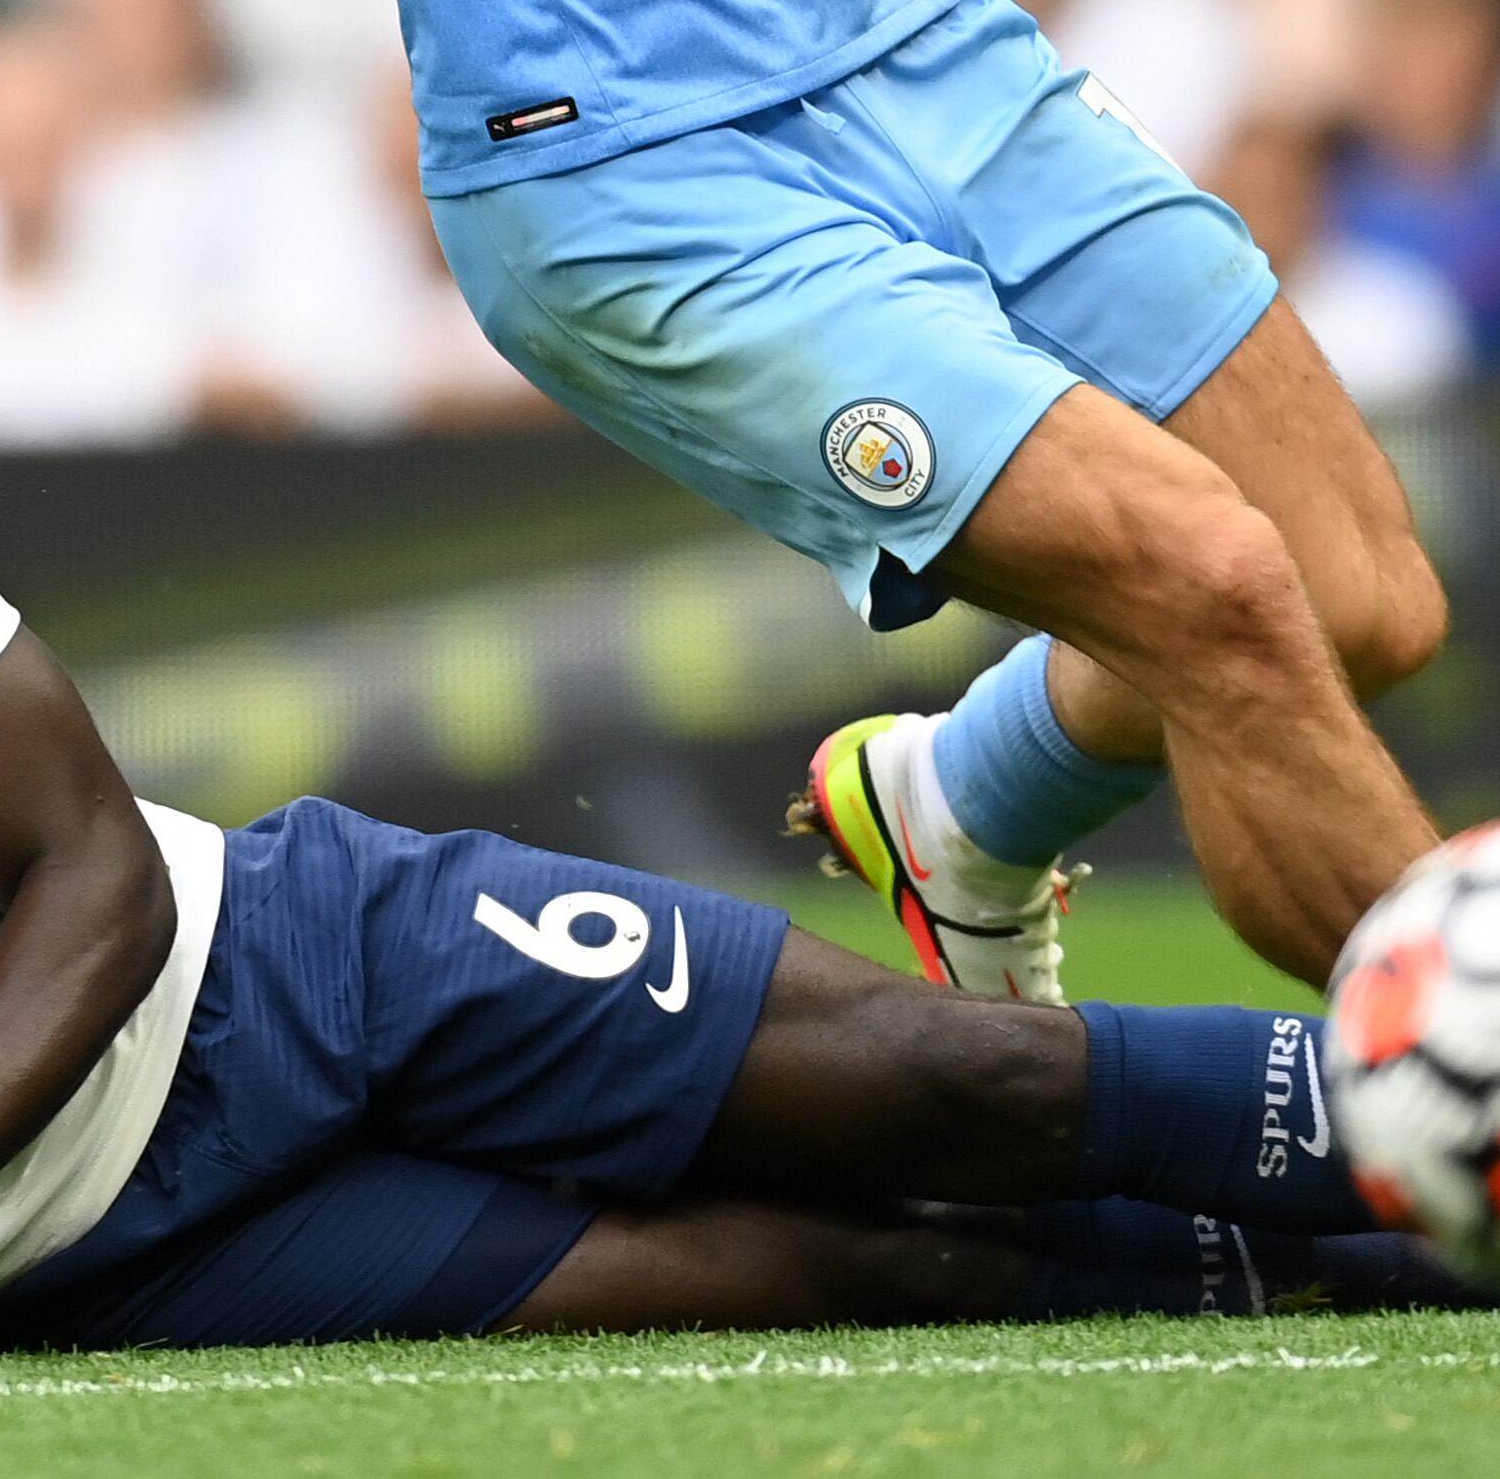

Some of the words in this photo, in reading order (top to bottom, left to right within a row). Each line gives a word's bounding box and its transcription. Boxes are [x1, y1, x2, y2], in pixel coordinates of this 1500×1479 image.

[829, 407, 887, 478] MANCHESTER
[904, 468, 926, 498] CITY
[472, 890, 651, 980] 6
[1256, 1016, 1303, 1178] SPURS
[1193, 1213, 1226, 1315] PUR
